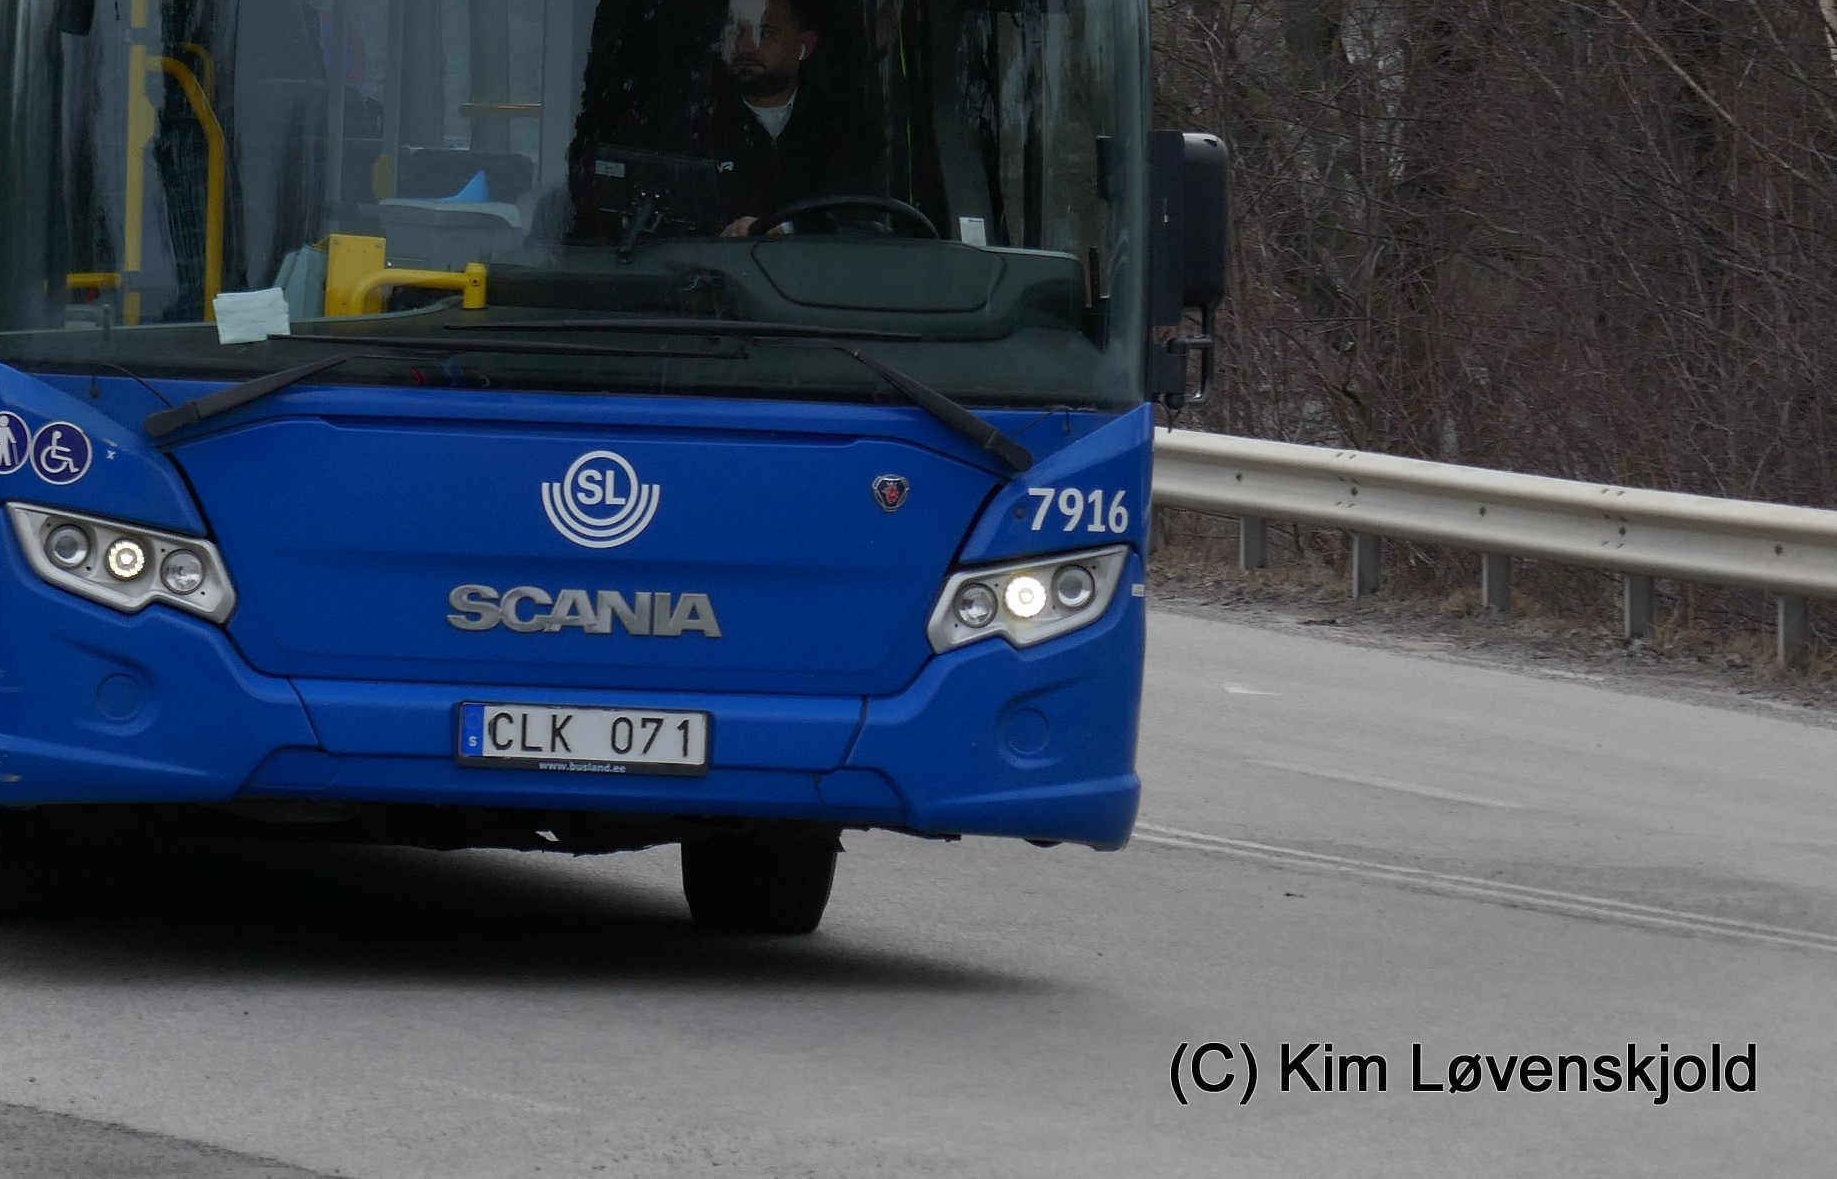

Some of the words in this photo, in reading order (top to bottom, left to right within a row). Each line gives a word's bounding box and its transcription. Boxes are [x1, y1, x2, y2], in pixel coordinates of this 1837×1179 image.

[576, 469, 627, 505] SL
[1028, 487, 1129, 534] 7916
[446, 584, 723, 638] SCANIA
[468, 735, 478, 747] S
[490, 712, 574, 753] CLK
[611, 716, 690, 758] 071
[538, 761, 627, 774] www.busland.ee
